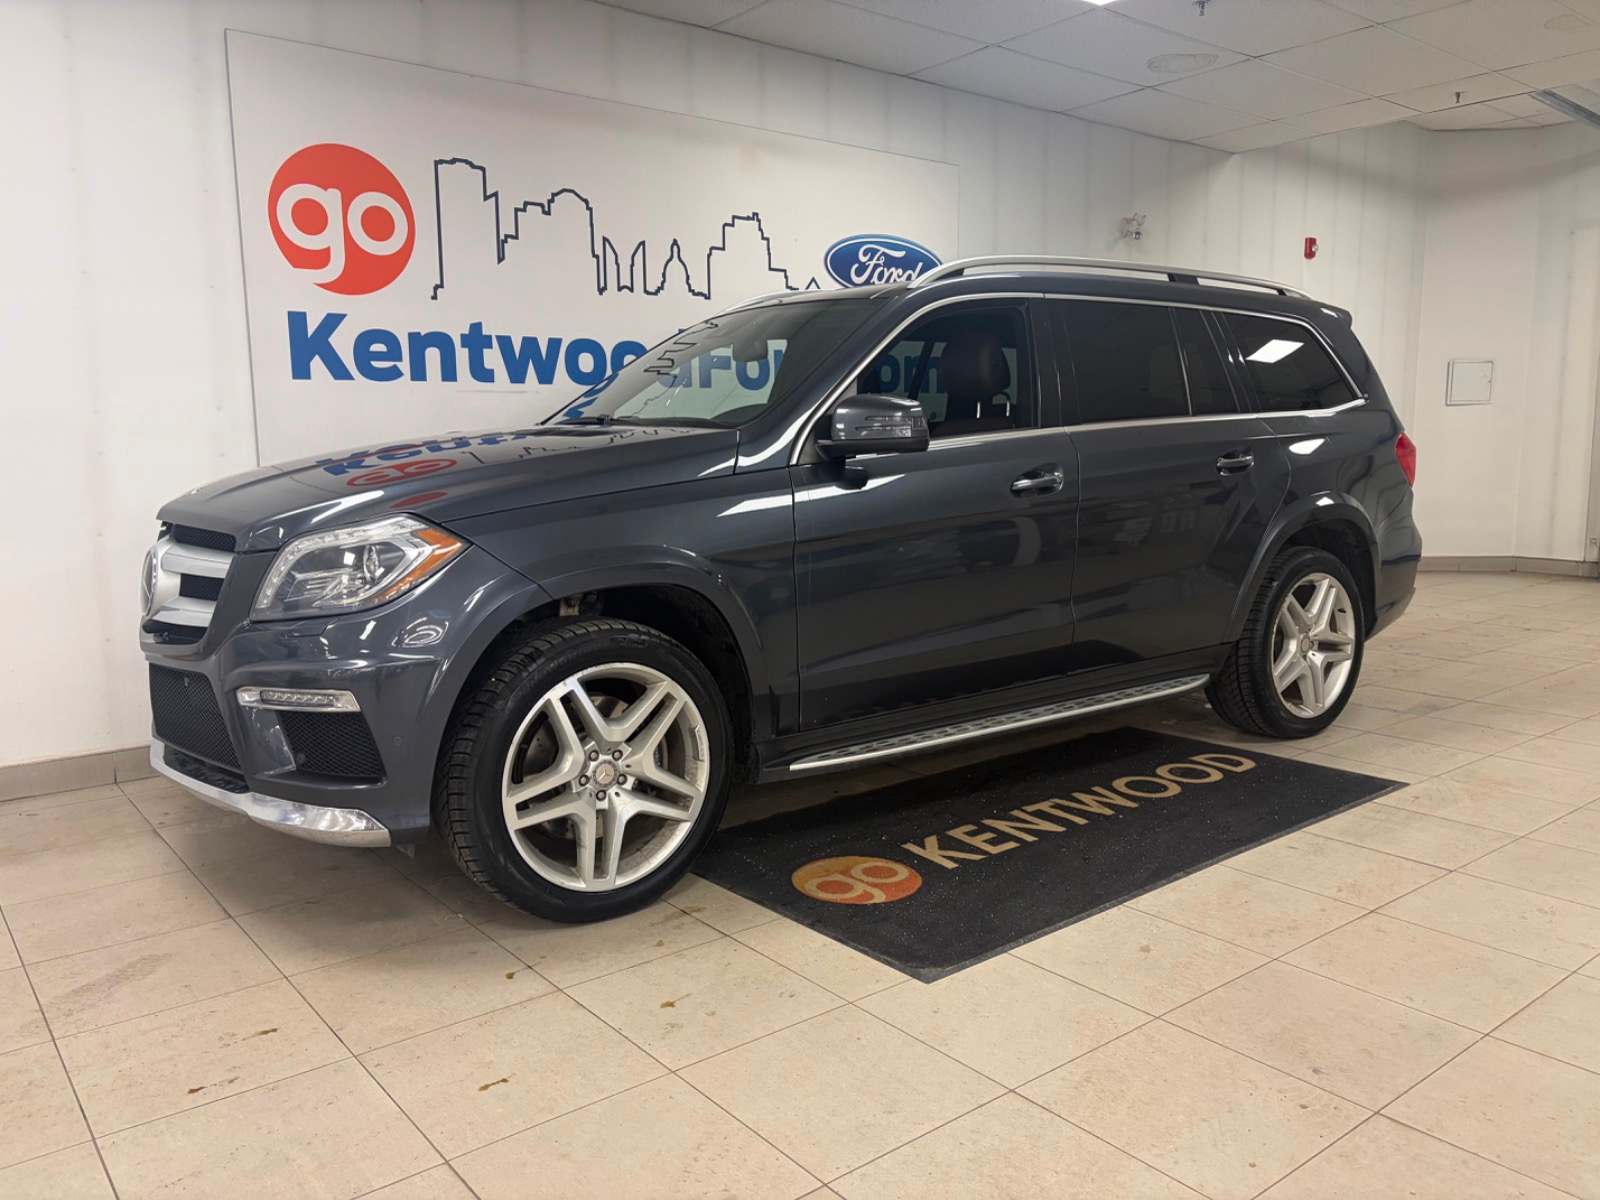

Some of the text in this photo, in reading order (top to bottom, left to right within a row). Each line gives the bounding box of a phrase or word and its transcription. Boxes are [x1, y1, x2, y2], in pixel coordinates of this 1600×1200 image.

[277, 183, 408, 284] go
[850, 244, 923, 284] Ford
[804, 754, 1256, 904] go KENTWOOD
